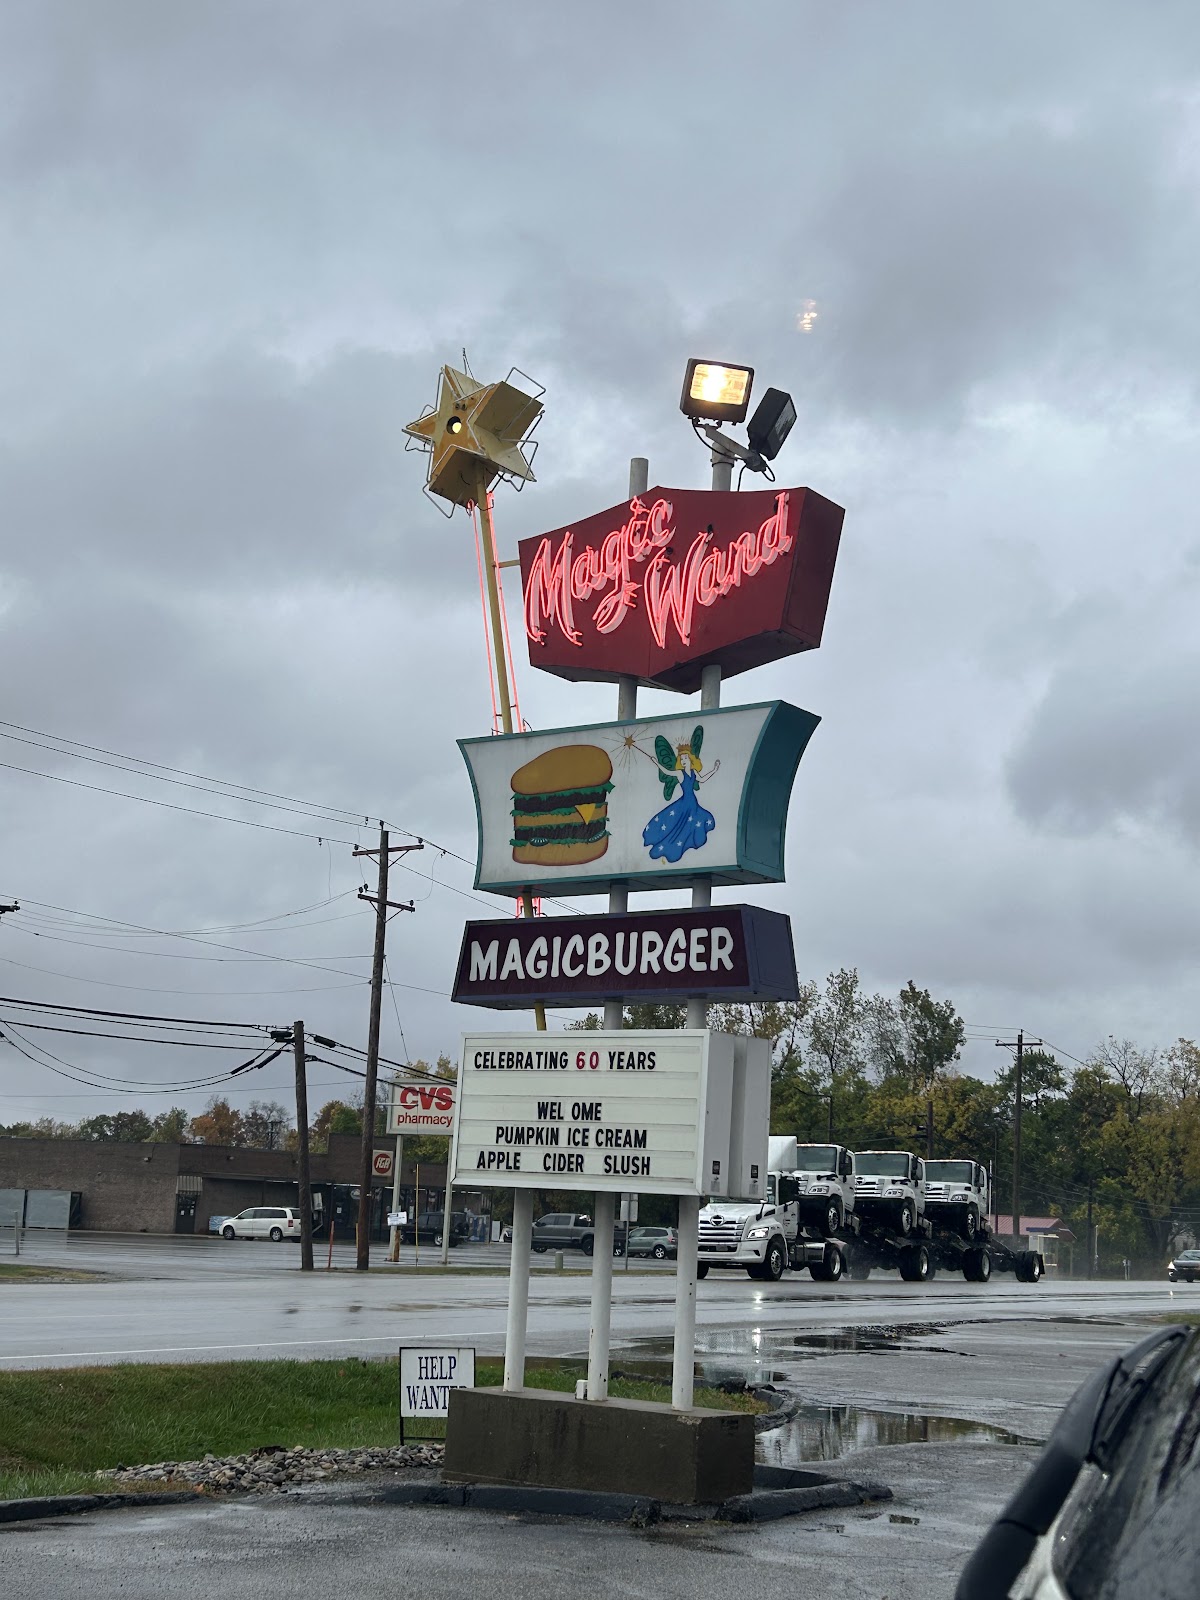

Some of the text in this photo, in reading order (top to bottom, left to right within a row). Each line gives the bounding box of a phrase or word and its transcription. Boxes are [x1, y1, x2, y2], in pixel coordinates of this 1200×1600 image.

[524, 496, 677, 646] Magic
[644, 492, 793, 649] Wand
[469, 927, 734, 982] MAGICBURGER
[474, 1051, 656, 1070] CELEBRATING 60 YEARS
[400, 1087, 453, 1111] CVS
[397, 1113, 453, 1127] pharmacy
[495, 1126, 647, 1149] PUMPKIN ICE CREAM
[477, 1151, 650, 1175] APPLE CIDER SLUSH
[418, 1356, 456, 1380] HELP
[406, 1385, 467, 1410] WANT
